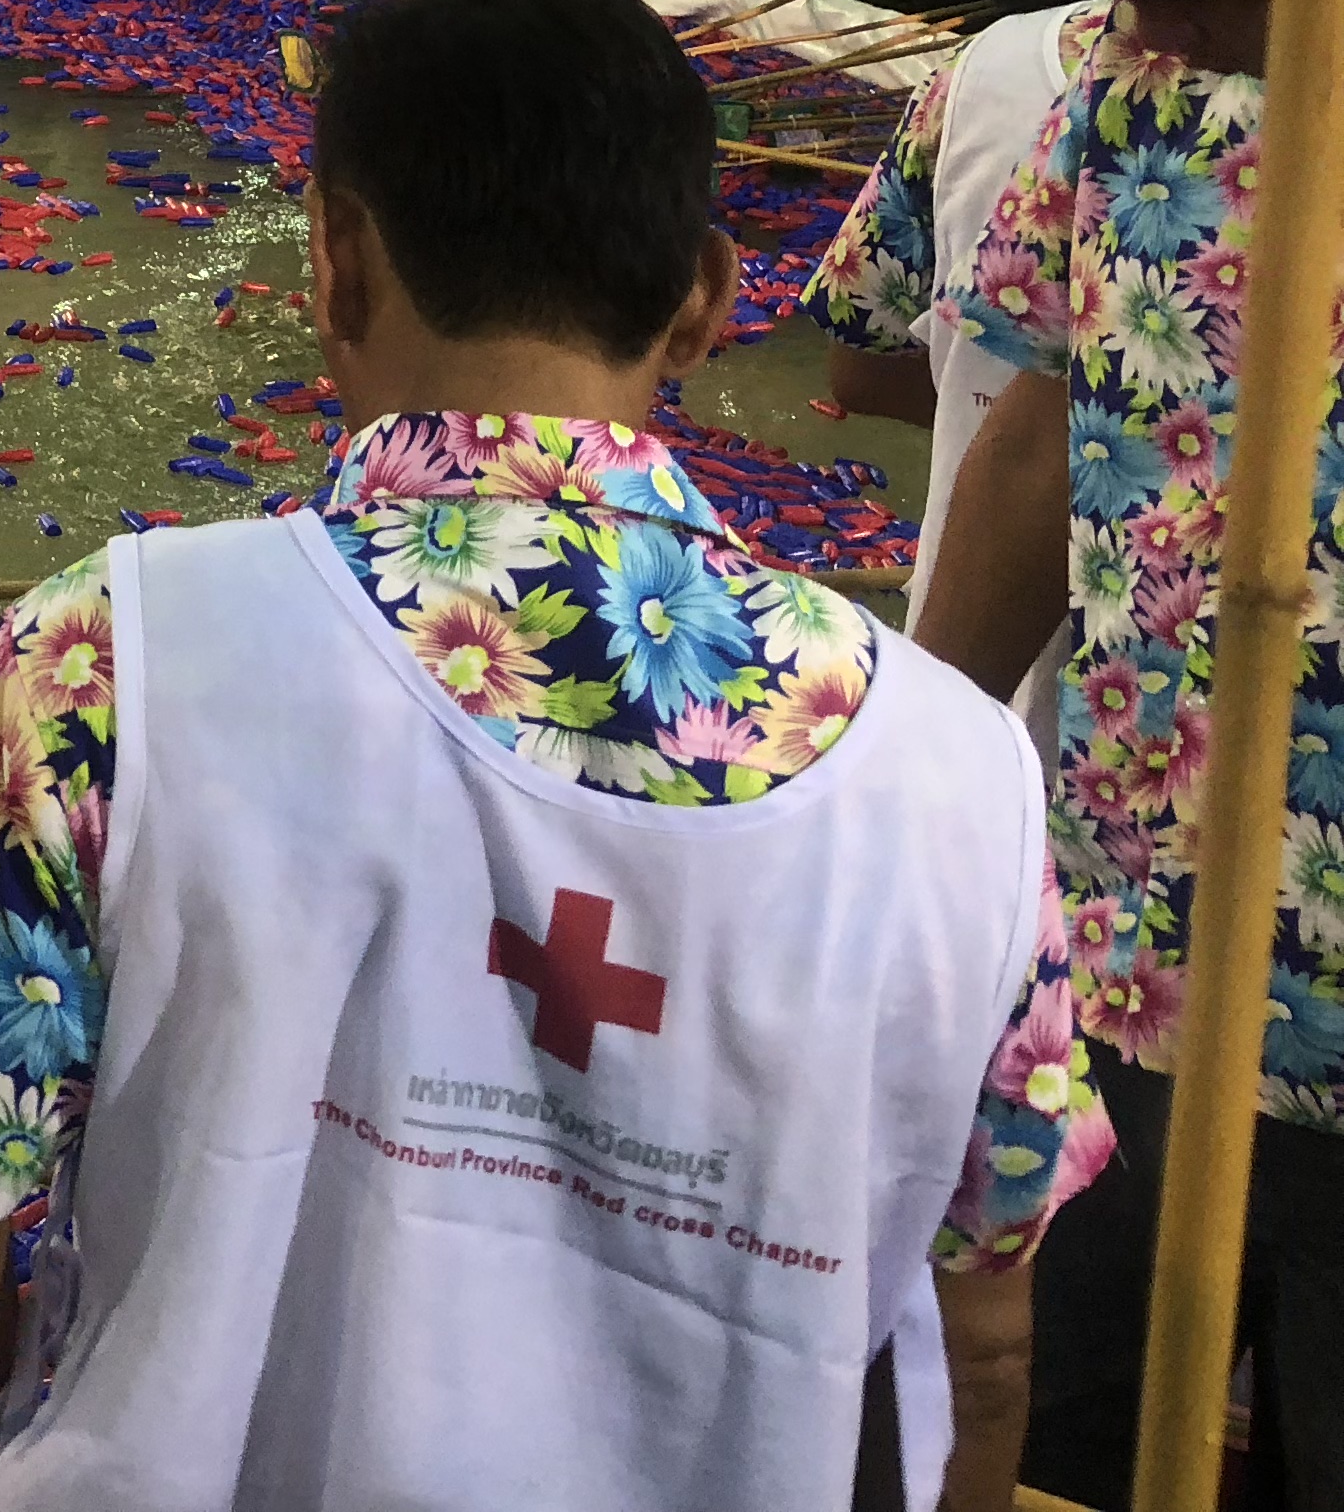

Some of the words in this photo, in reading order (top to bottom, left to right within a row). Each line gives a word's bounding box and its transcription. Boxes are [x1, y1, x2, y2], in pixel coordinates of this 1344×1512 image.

[971, 391, 994, 408] Th
[311, 1099, 352, 1128] The
[353, 1116, 458, 1170] Chonburi
[459, 1147, 563, 1185] Province
[571, 1173, 626, 1216] Red
[725, 1224, 843, 1275] Chapter
[407, 1068, 731, 1189] เหล่ากาชาดจังหวัดชลบุรี
